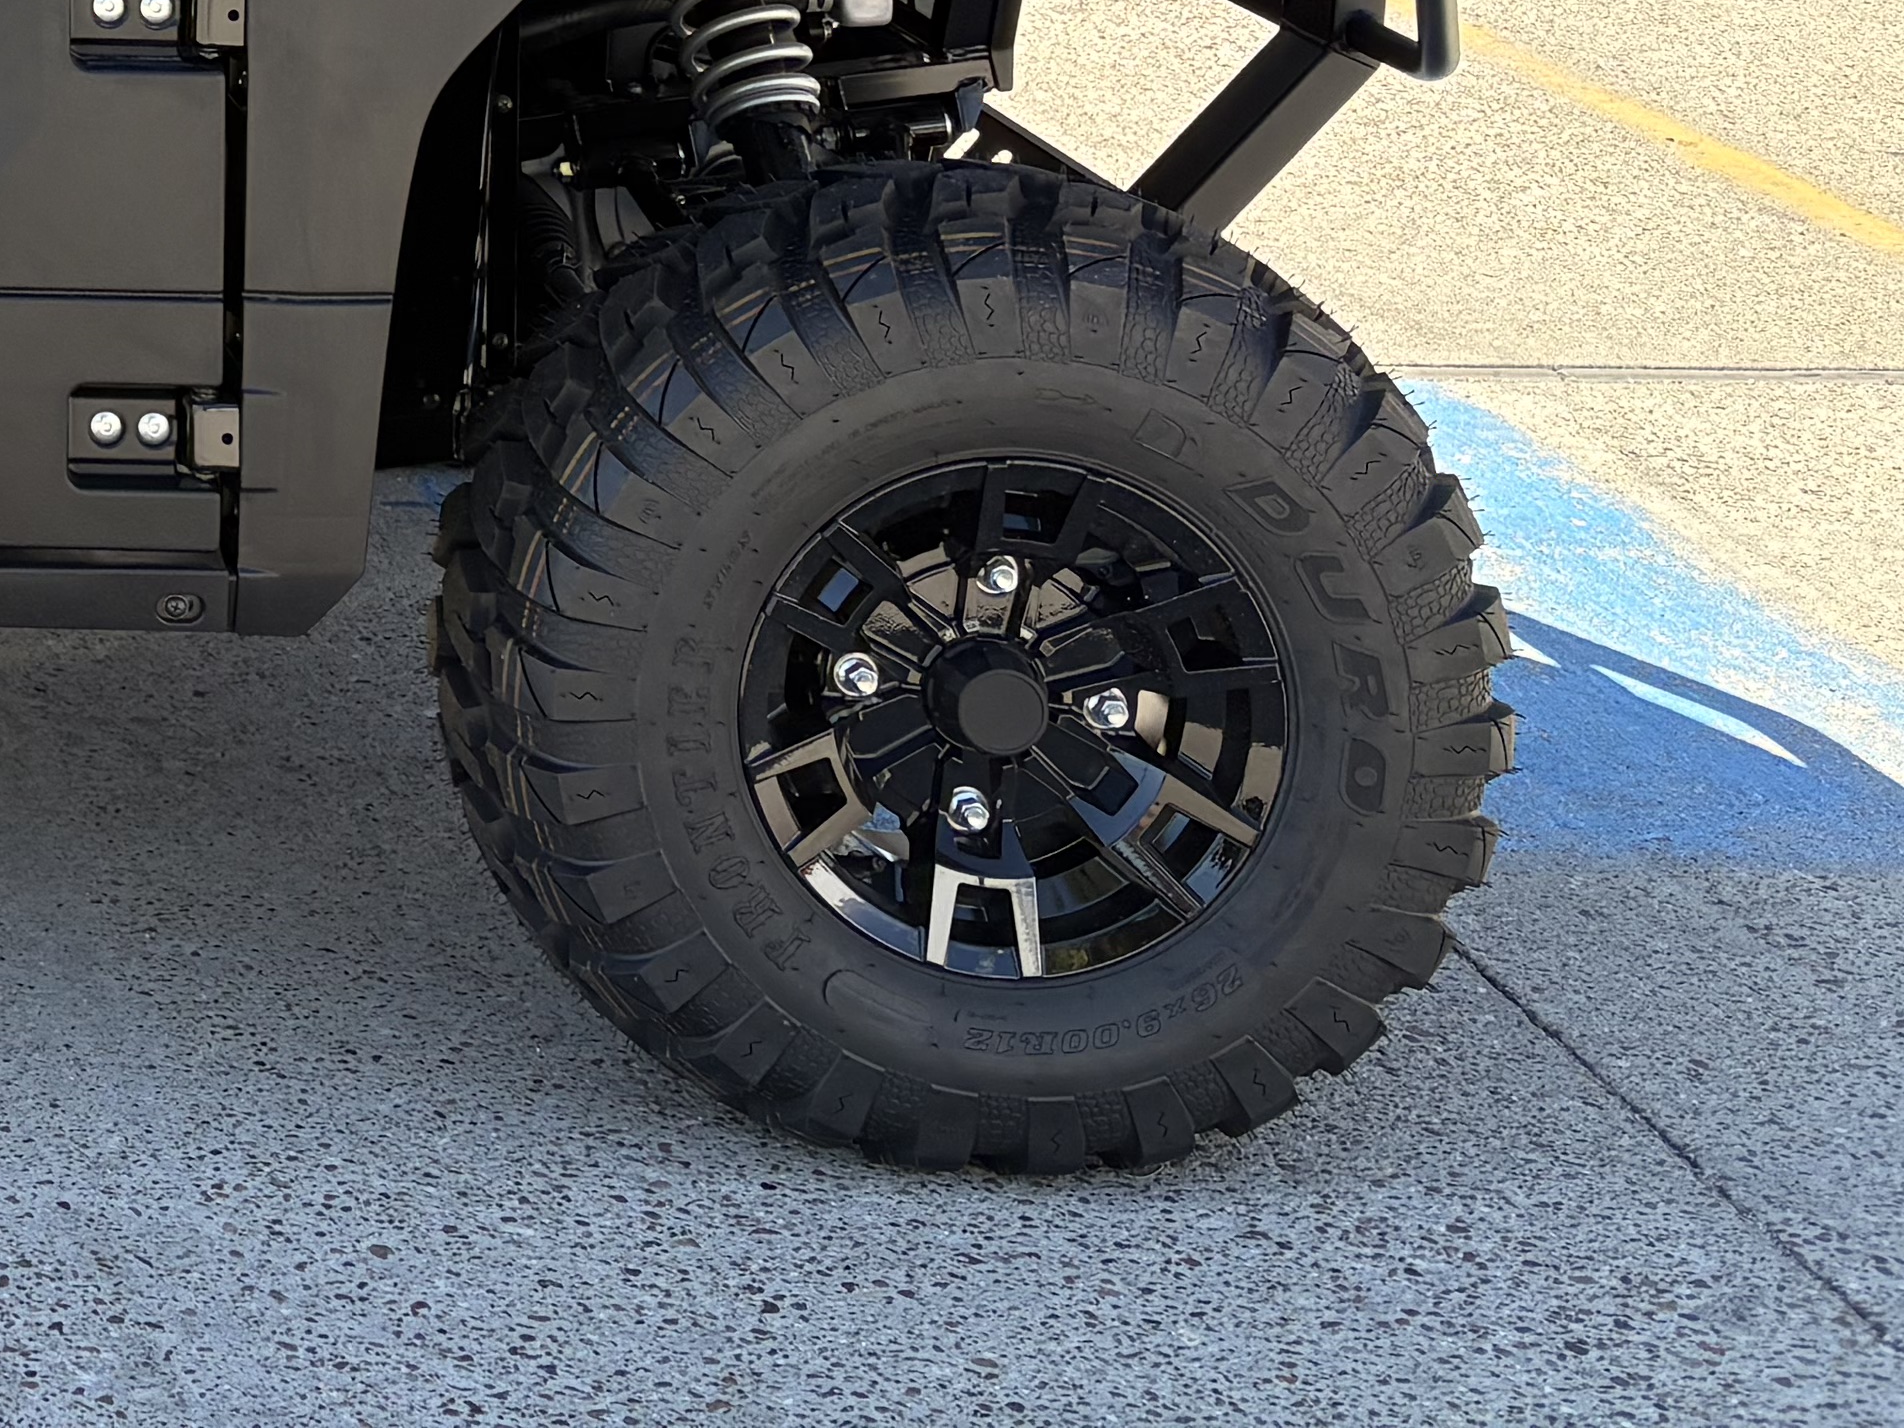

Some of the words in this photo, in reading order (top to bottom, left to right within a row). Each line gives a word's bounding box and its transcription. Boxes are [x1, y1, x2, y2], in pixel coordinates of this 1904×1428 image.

[664, 635, 813, 973] FRONTIER
[1221, 474, 1390, 816] DURO
[962, 962, 1244, 1056] 26x9.00R12
